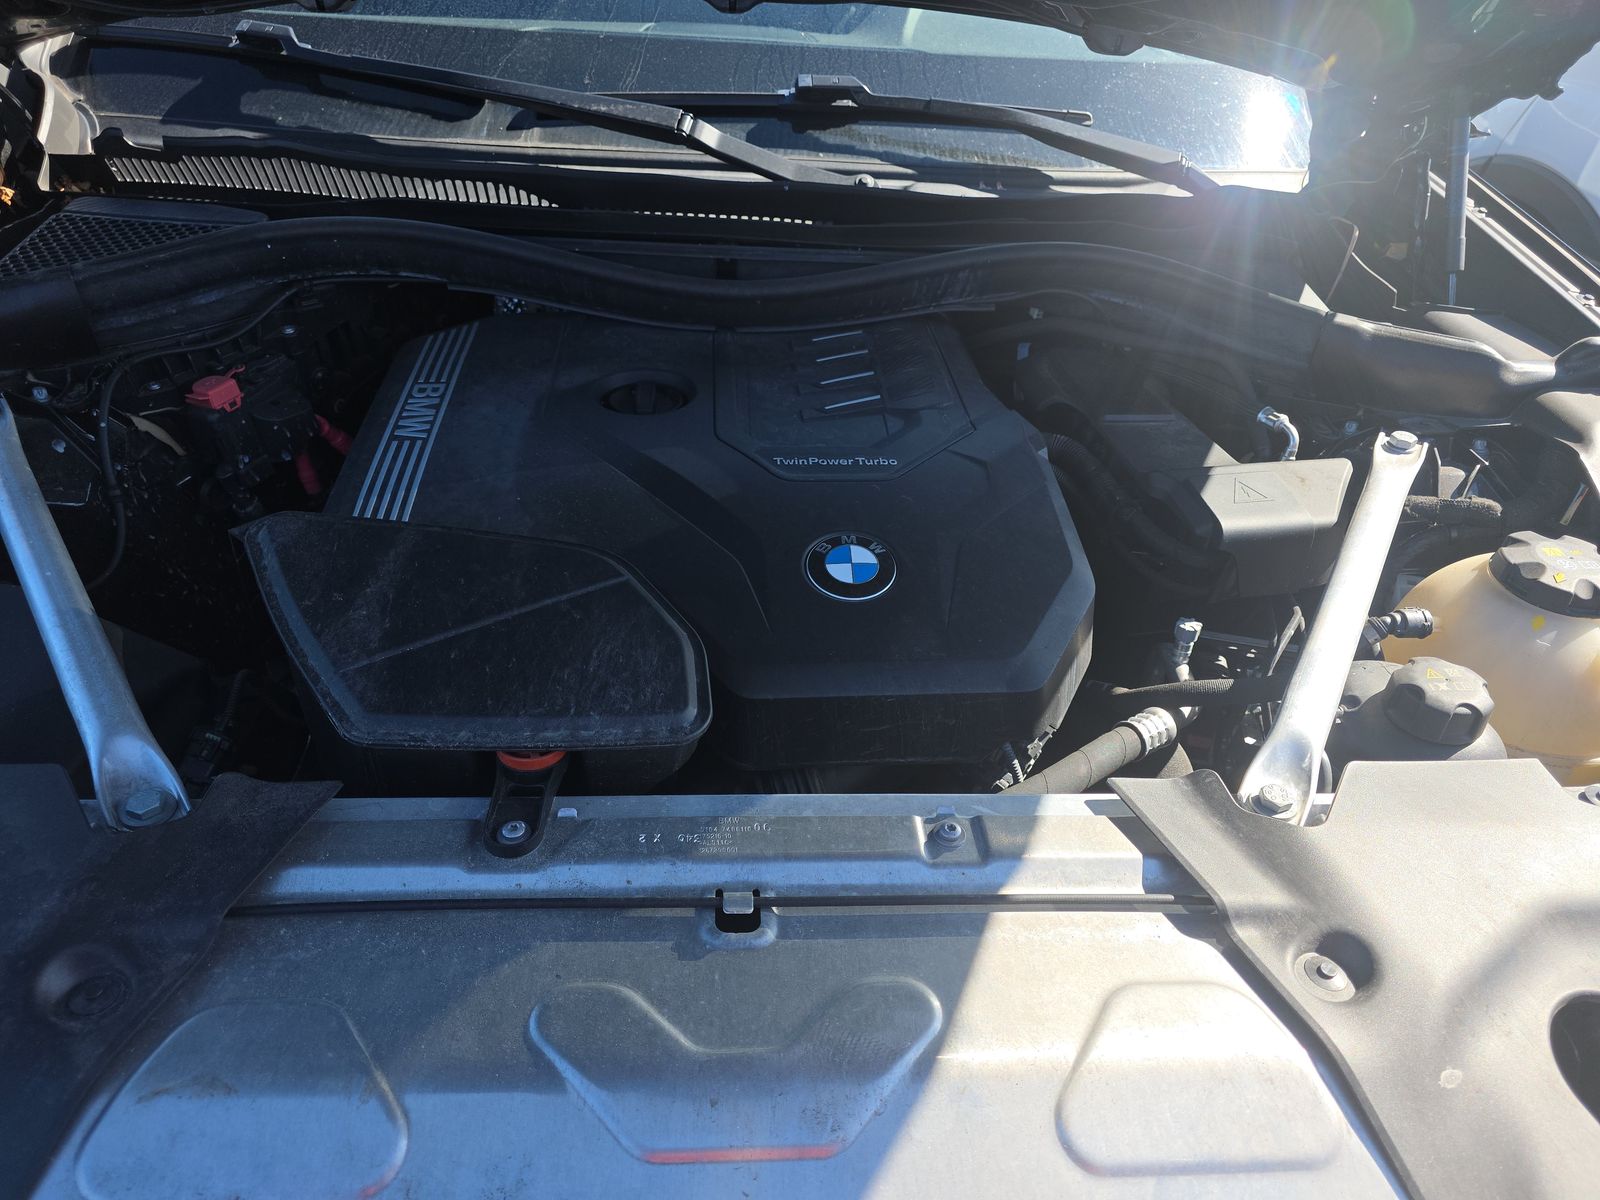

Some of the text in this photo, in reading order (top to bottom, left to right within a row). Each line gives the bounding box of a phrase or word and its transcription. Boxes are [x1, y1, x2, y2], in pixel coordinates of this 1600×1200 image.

[394, 383, 447, 439] BMW
[773, 457, 898, 467] TwinPower Turbo
[718, 816, 741, 825] BMW
[638, 833, 646, 843] 2
[653, 833, 661, 843] X
